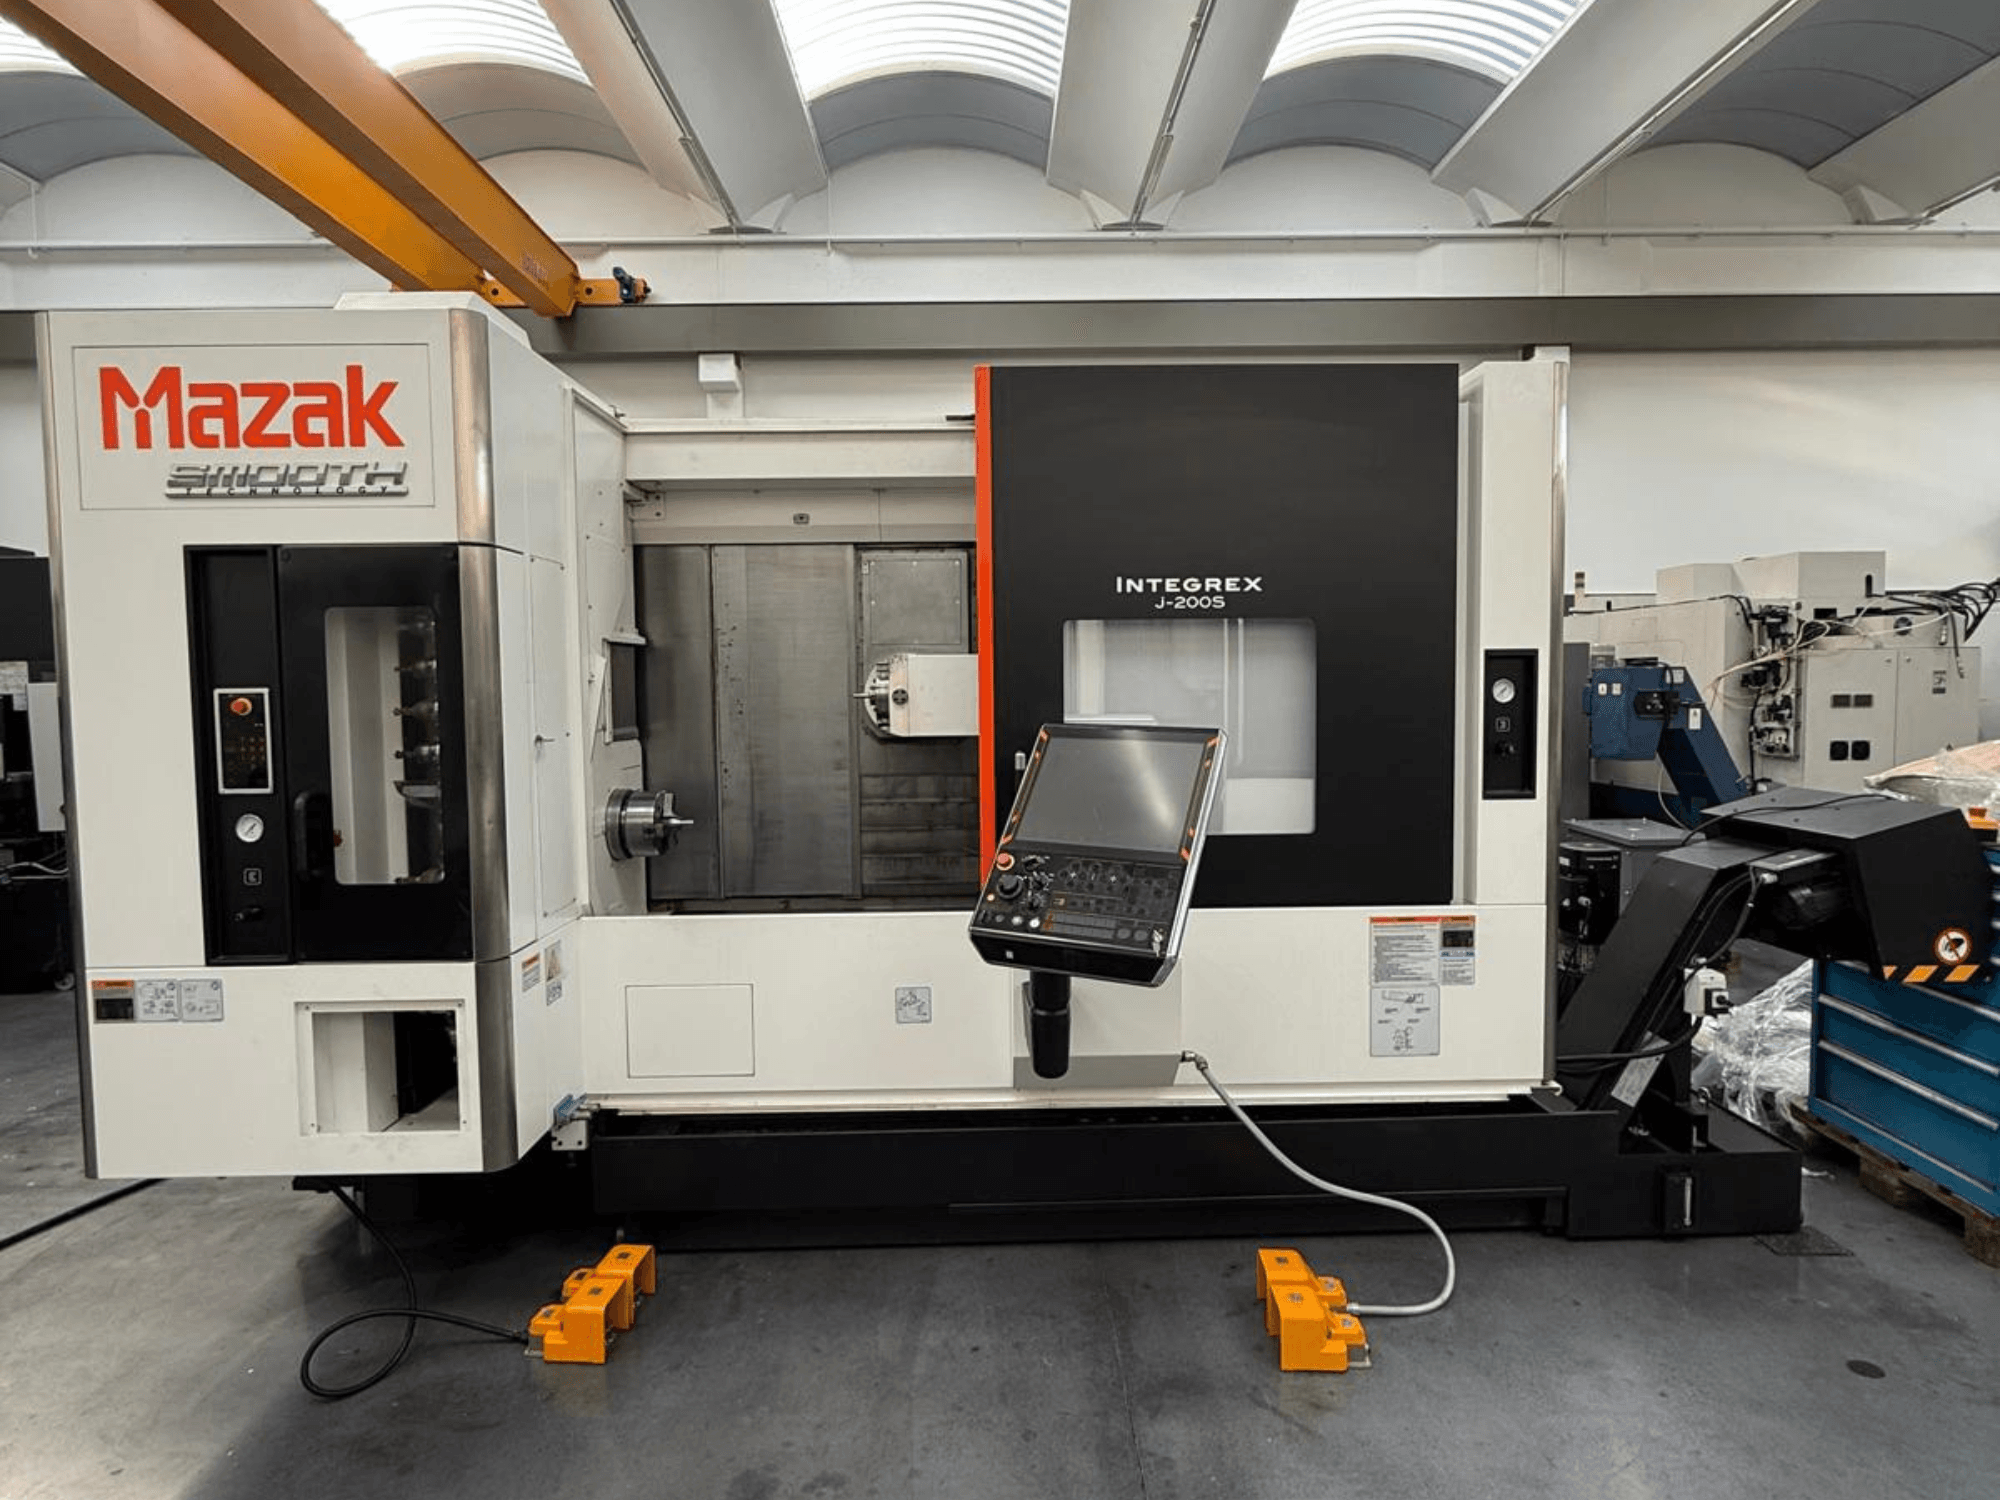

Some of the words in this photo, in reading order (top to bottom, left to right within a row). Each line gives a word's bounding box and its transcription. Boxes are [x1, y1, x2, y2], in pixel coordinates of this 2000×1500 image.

[99, 365, 404, 449] Mazak
[167, 463, 408, 487] SMOOTH
[186, 487, 388, 496] TECHNOLOGY
[1154, 596, 1226, 609] J-200S
